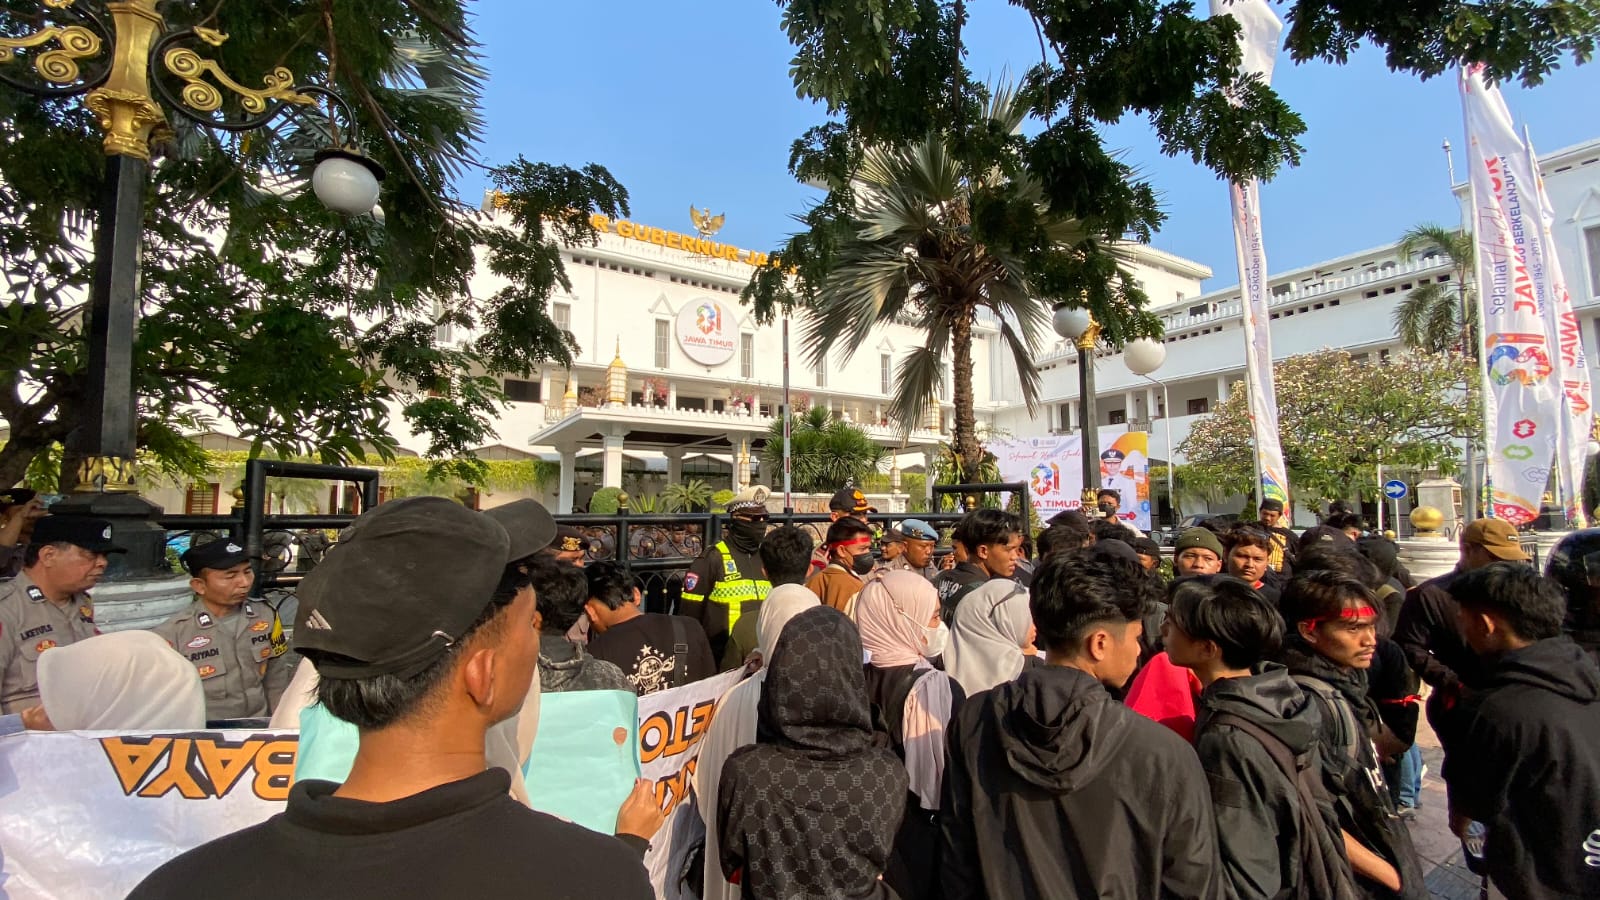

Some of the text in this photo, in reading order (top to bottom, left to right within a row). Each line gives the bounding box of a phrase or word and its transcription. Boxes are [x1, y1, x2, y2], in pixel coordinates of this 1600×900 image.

[616, 221, 739, 262] GUBERNUR
[1250, 254, 1260, 292] Oktober
[1490, 261, 1507, 315] Selamat
[683, 335, 707, 345] JAWA
[707, 338, 734, 348] TIMUR
[1559, 311, 1578, 367] JAWA
[1045, 500, 1081, 508] TIMUR
